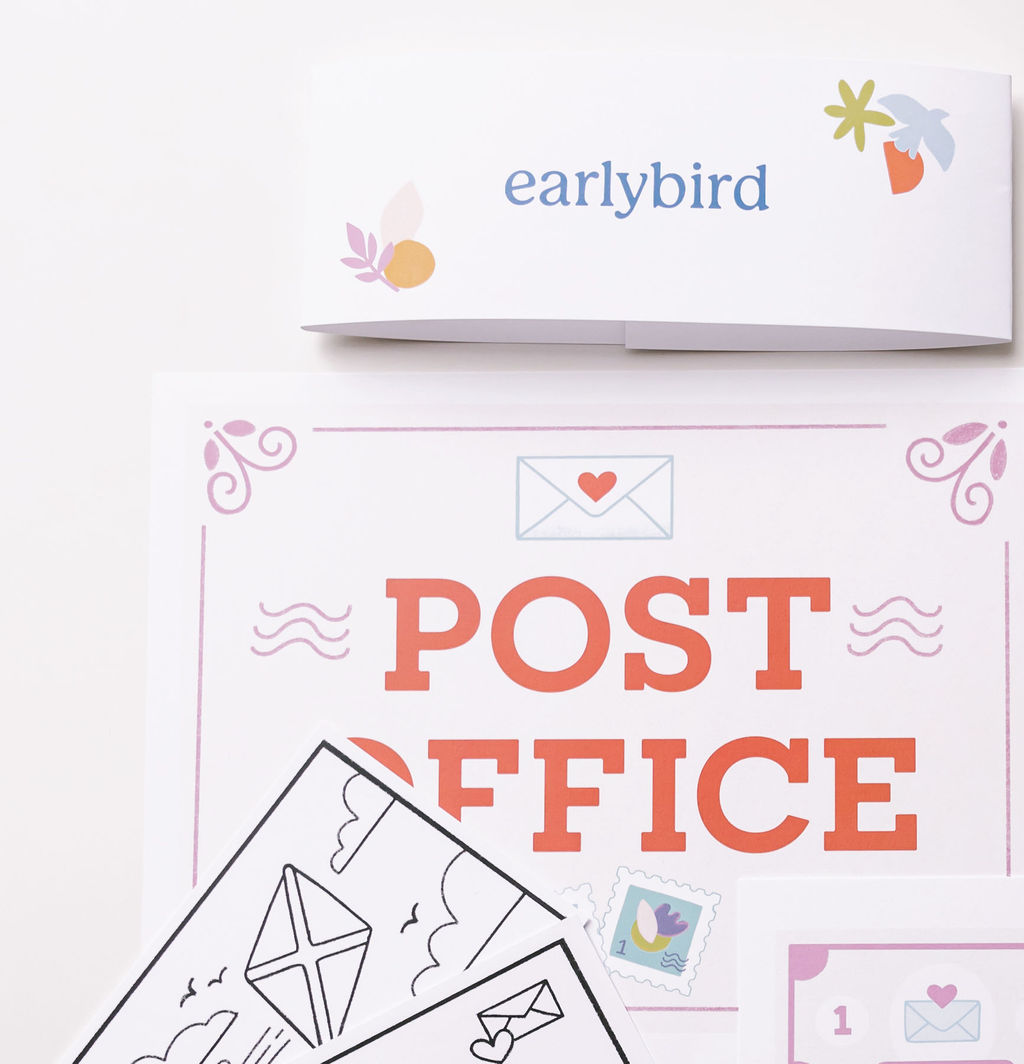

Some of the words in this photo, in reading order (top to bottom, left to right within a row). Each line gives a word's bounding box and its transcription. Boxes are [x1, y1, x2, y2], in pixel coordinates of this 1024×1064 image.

[505, 161, 769, 219] earlybird
[385, 576, 831, 693] POST
[347, 735, 917, 853] FFICE
[615, 939, 628, 957] 1
[834, 1005, 852, 1035] 1
